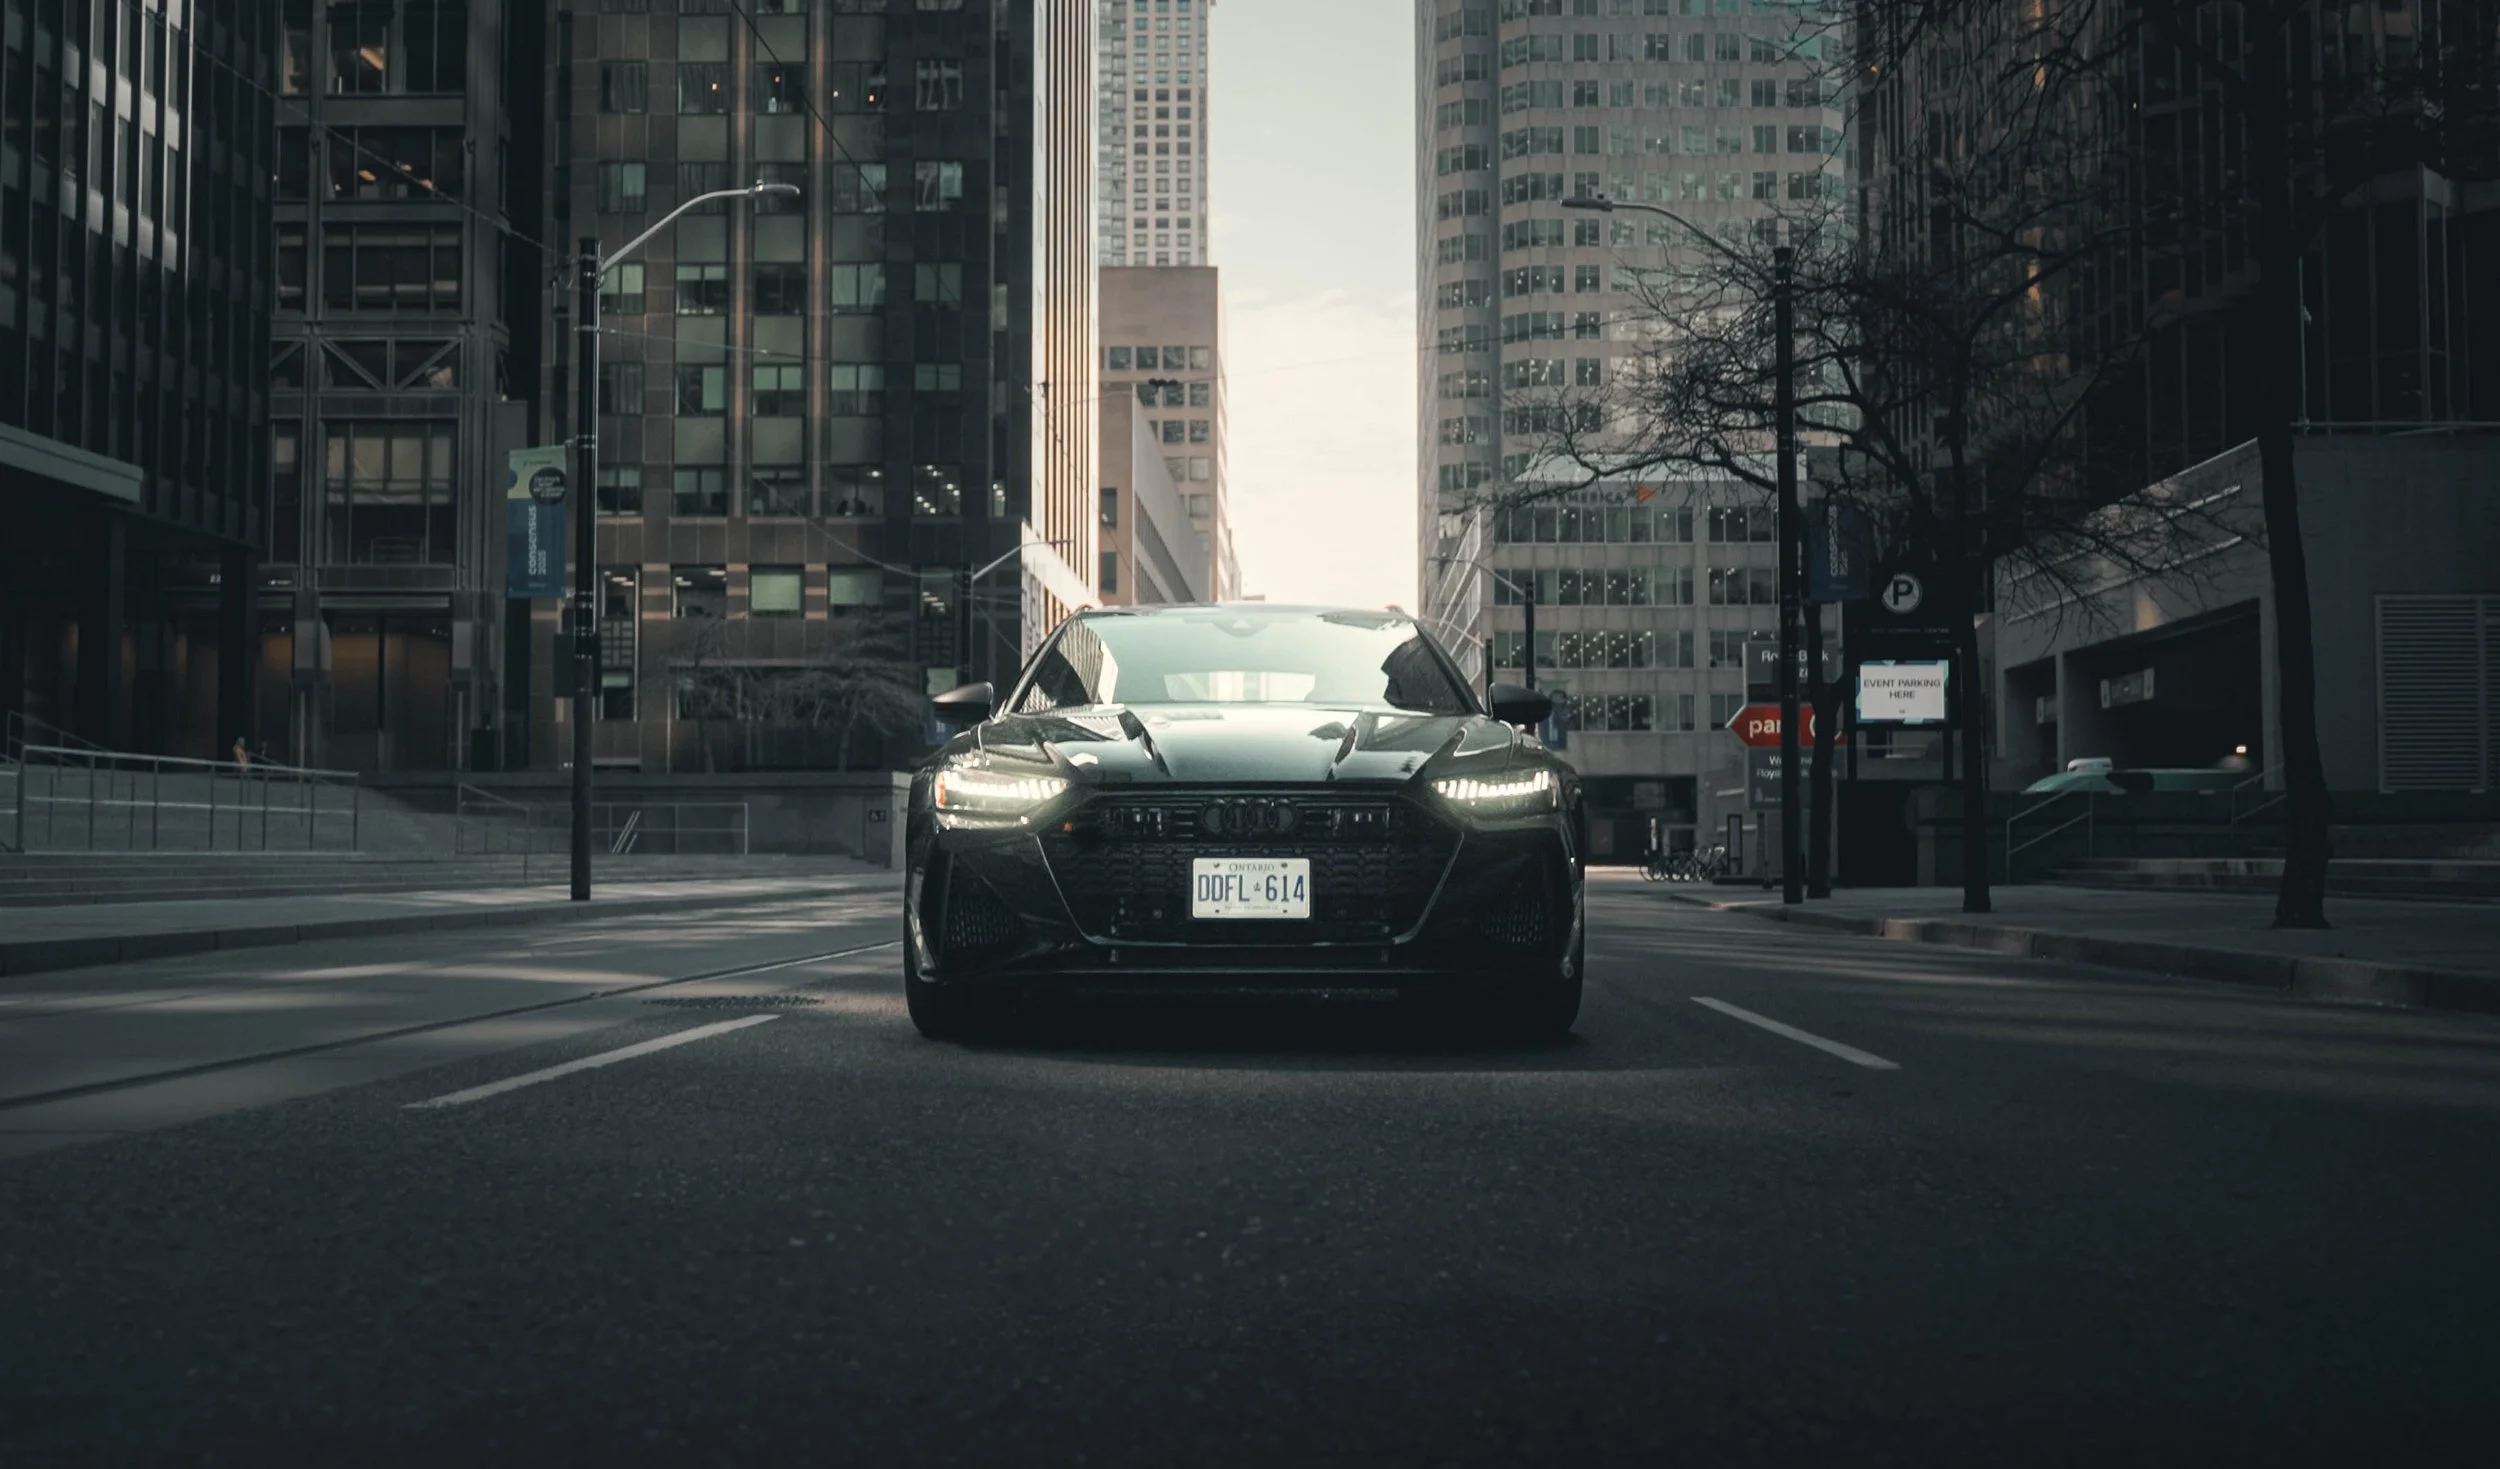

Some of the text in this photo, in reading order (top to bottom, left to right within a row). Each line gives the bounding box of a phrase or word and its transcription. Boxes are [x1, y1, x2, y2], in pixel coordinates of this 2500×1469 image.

[528, 504, 538, 576] consensus
[1892, 580, 1914, 606] P
[1863, 678, 1941, 689] EVENT PARKING
[1888, 690, 1916, 700] HERE
[1228, 863, 1275, 873] ONTARIO
[1197, 874, 1304, 902] DDFL 614
